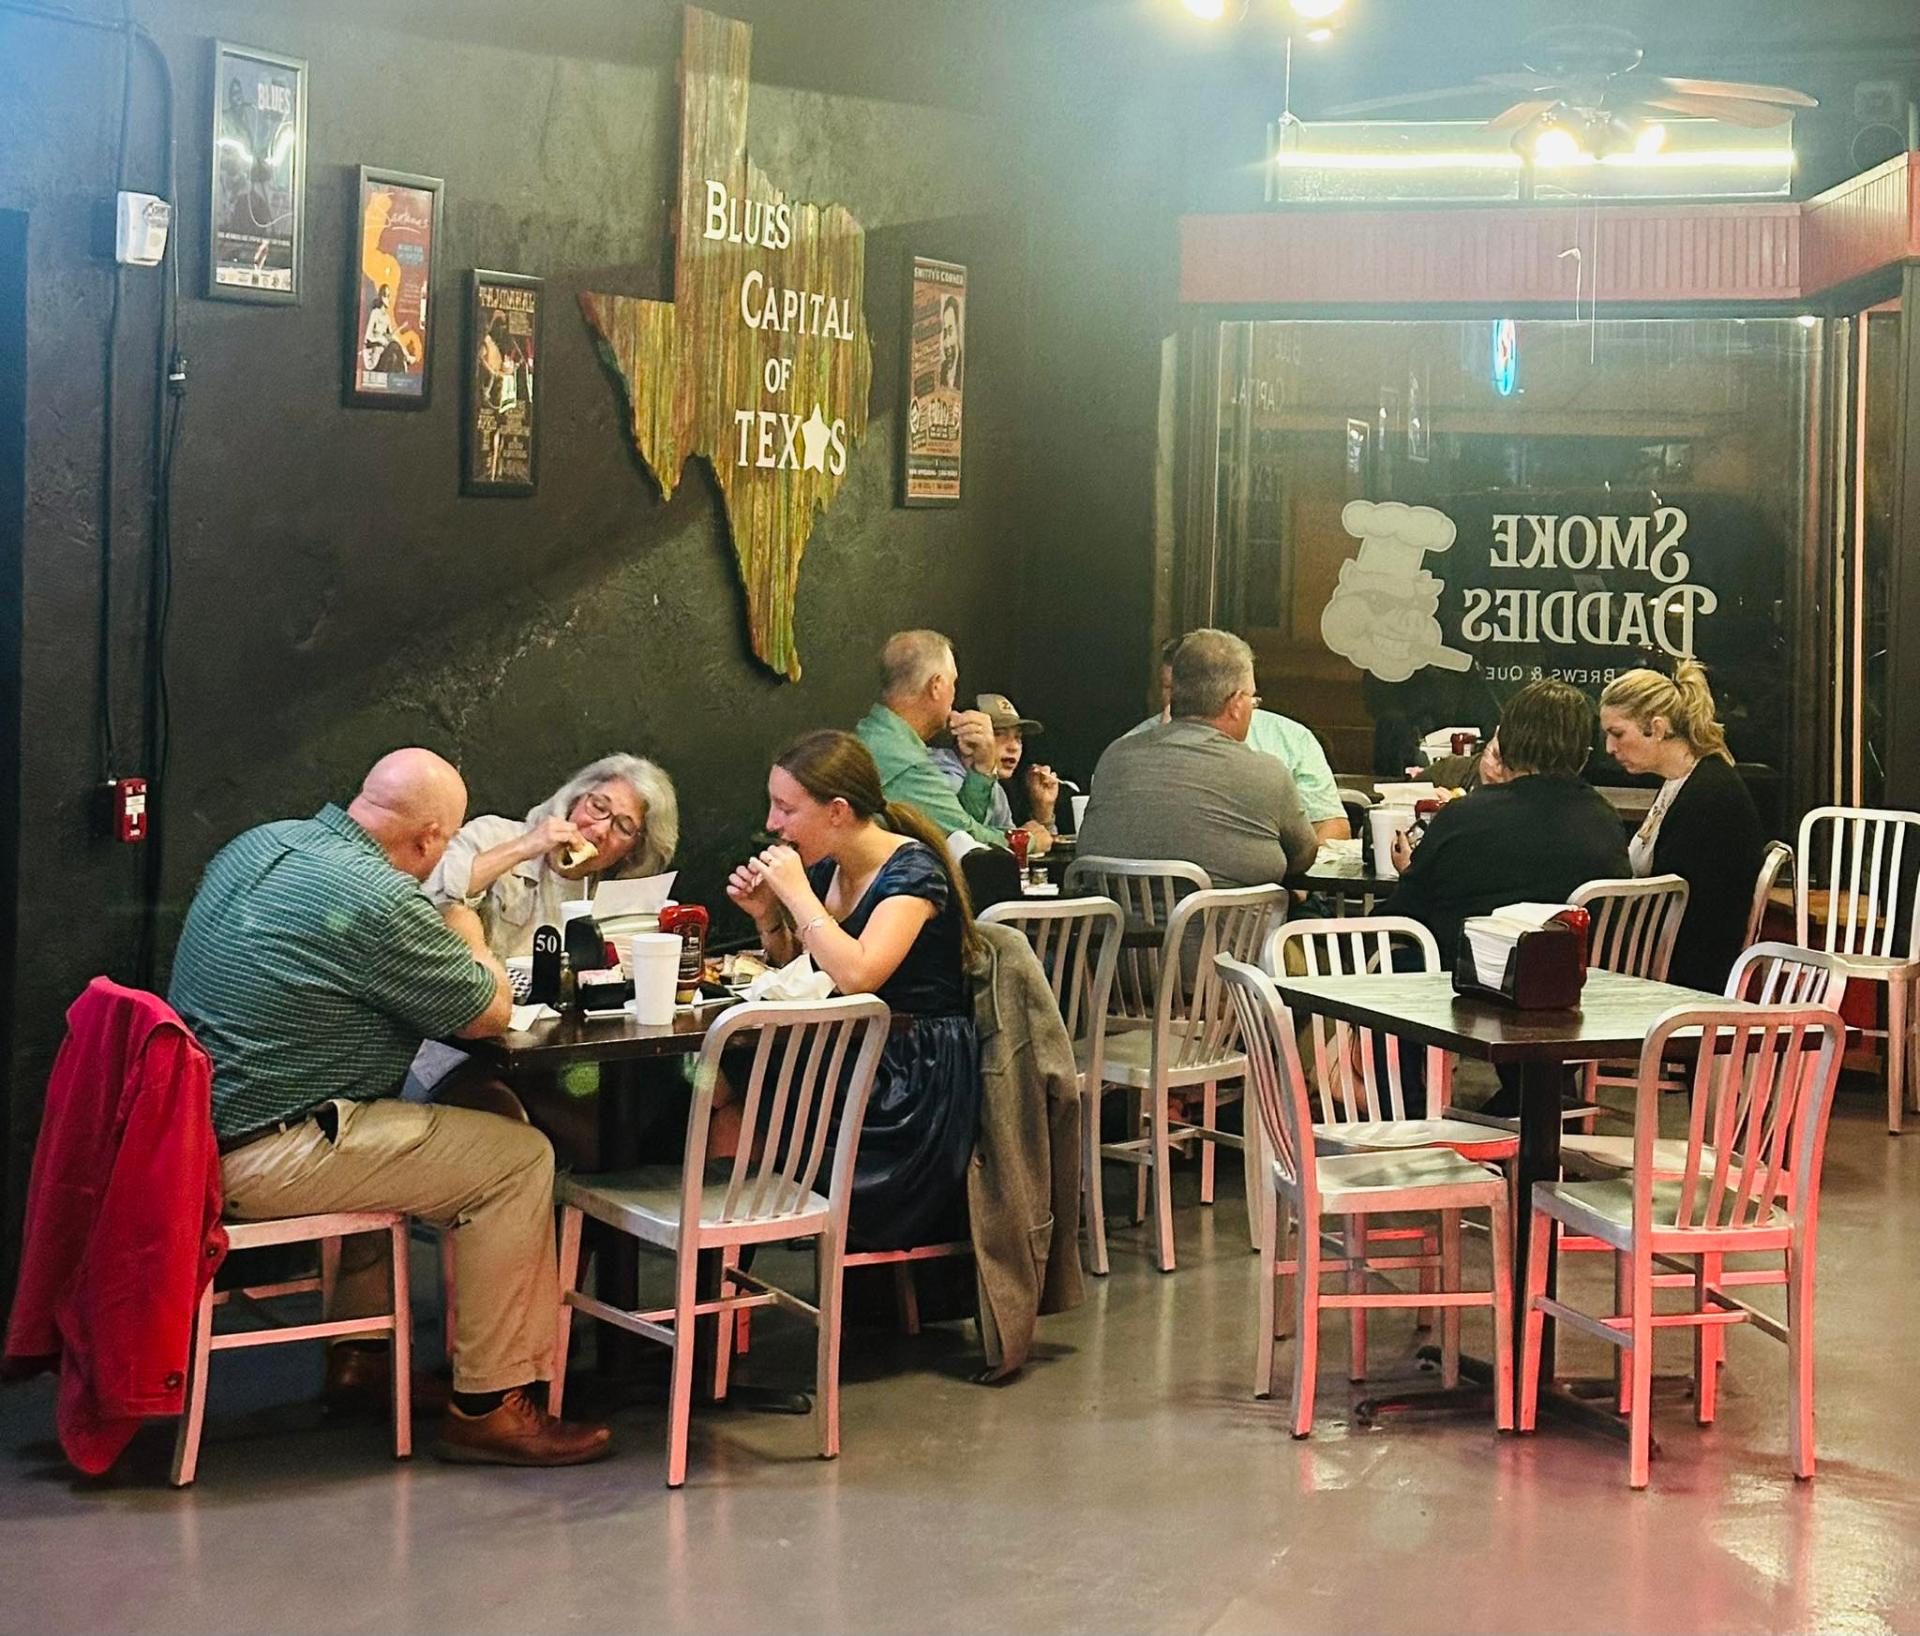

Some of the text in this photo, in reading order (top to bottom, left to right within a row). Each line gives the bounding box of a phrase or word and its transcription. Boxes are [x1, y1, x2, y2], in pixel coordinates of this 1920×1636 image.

[257, 82, 291, 114] BLUES
[703, 179, 791, 250] BLUES
[741, 269, 854, 341] CAPITAL
[764, 357, 793, 394] OF
[535, 934, 557, 954] 50
